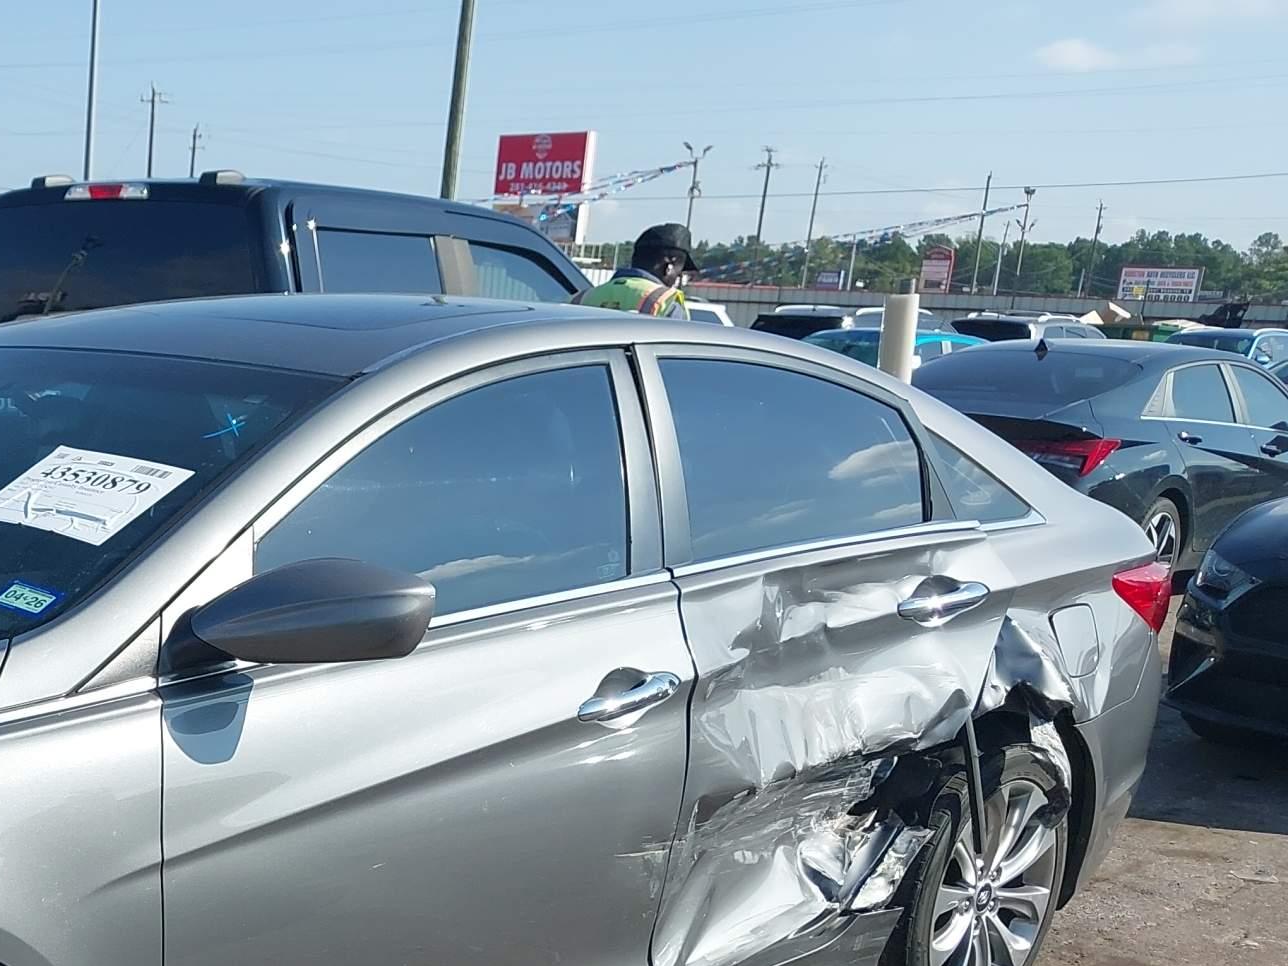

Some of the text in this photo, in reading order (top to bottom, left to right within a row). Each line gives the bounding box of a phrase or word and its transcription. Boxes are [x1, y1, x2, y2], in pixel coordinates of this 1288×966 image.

[498, 160, 582, 180] JB MOTORS
[41, 464, 152, 495] 43530879
[4, 590, 22, 602] 04
[25, 596, 48, 609] 26
